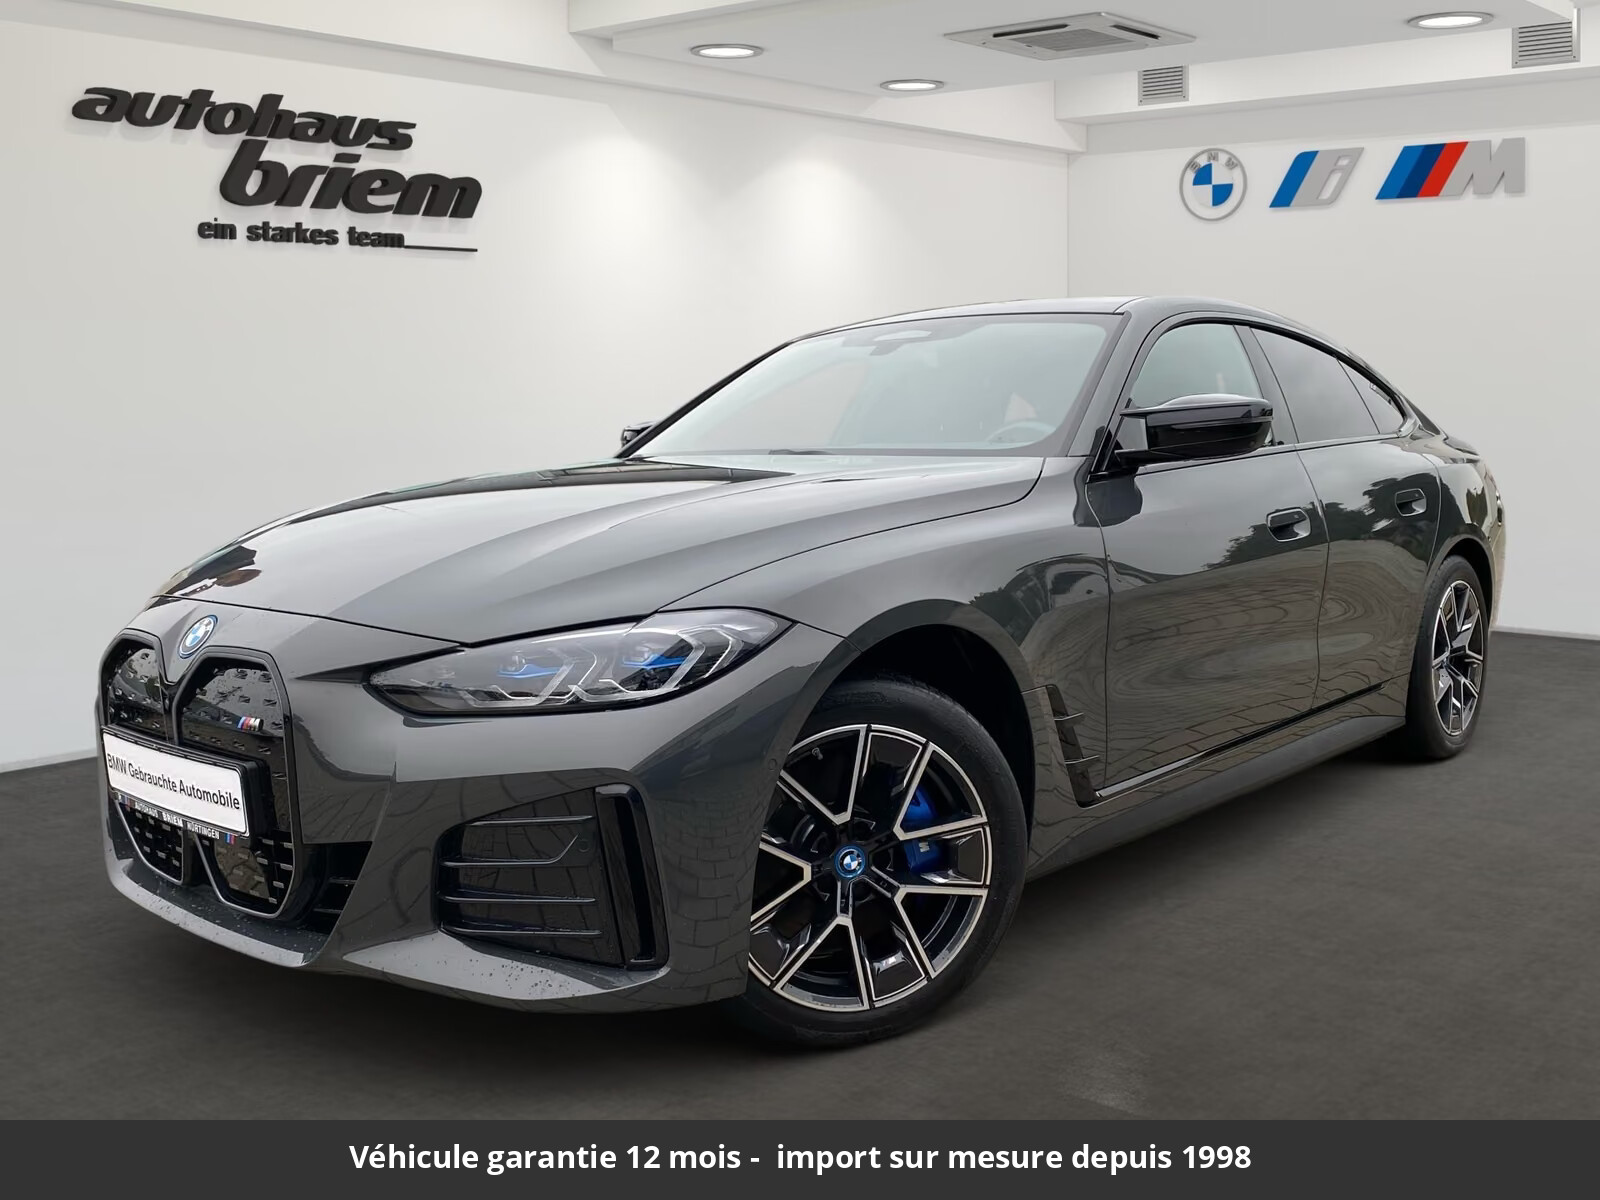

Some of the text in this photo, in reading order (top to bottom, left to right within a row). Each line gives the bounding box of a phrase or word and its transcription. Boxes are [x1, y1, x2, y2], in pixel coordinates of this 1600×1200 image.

[72, 86, 417, 151] autohaus
[219, 138, 483, 219] briem
[197, 217, 406, 249] ein starkes team
[106, 753, 240, 810] BMW Gebrauchte Automobile
[162, 811, 184, 828] BRIEM
